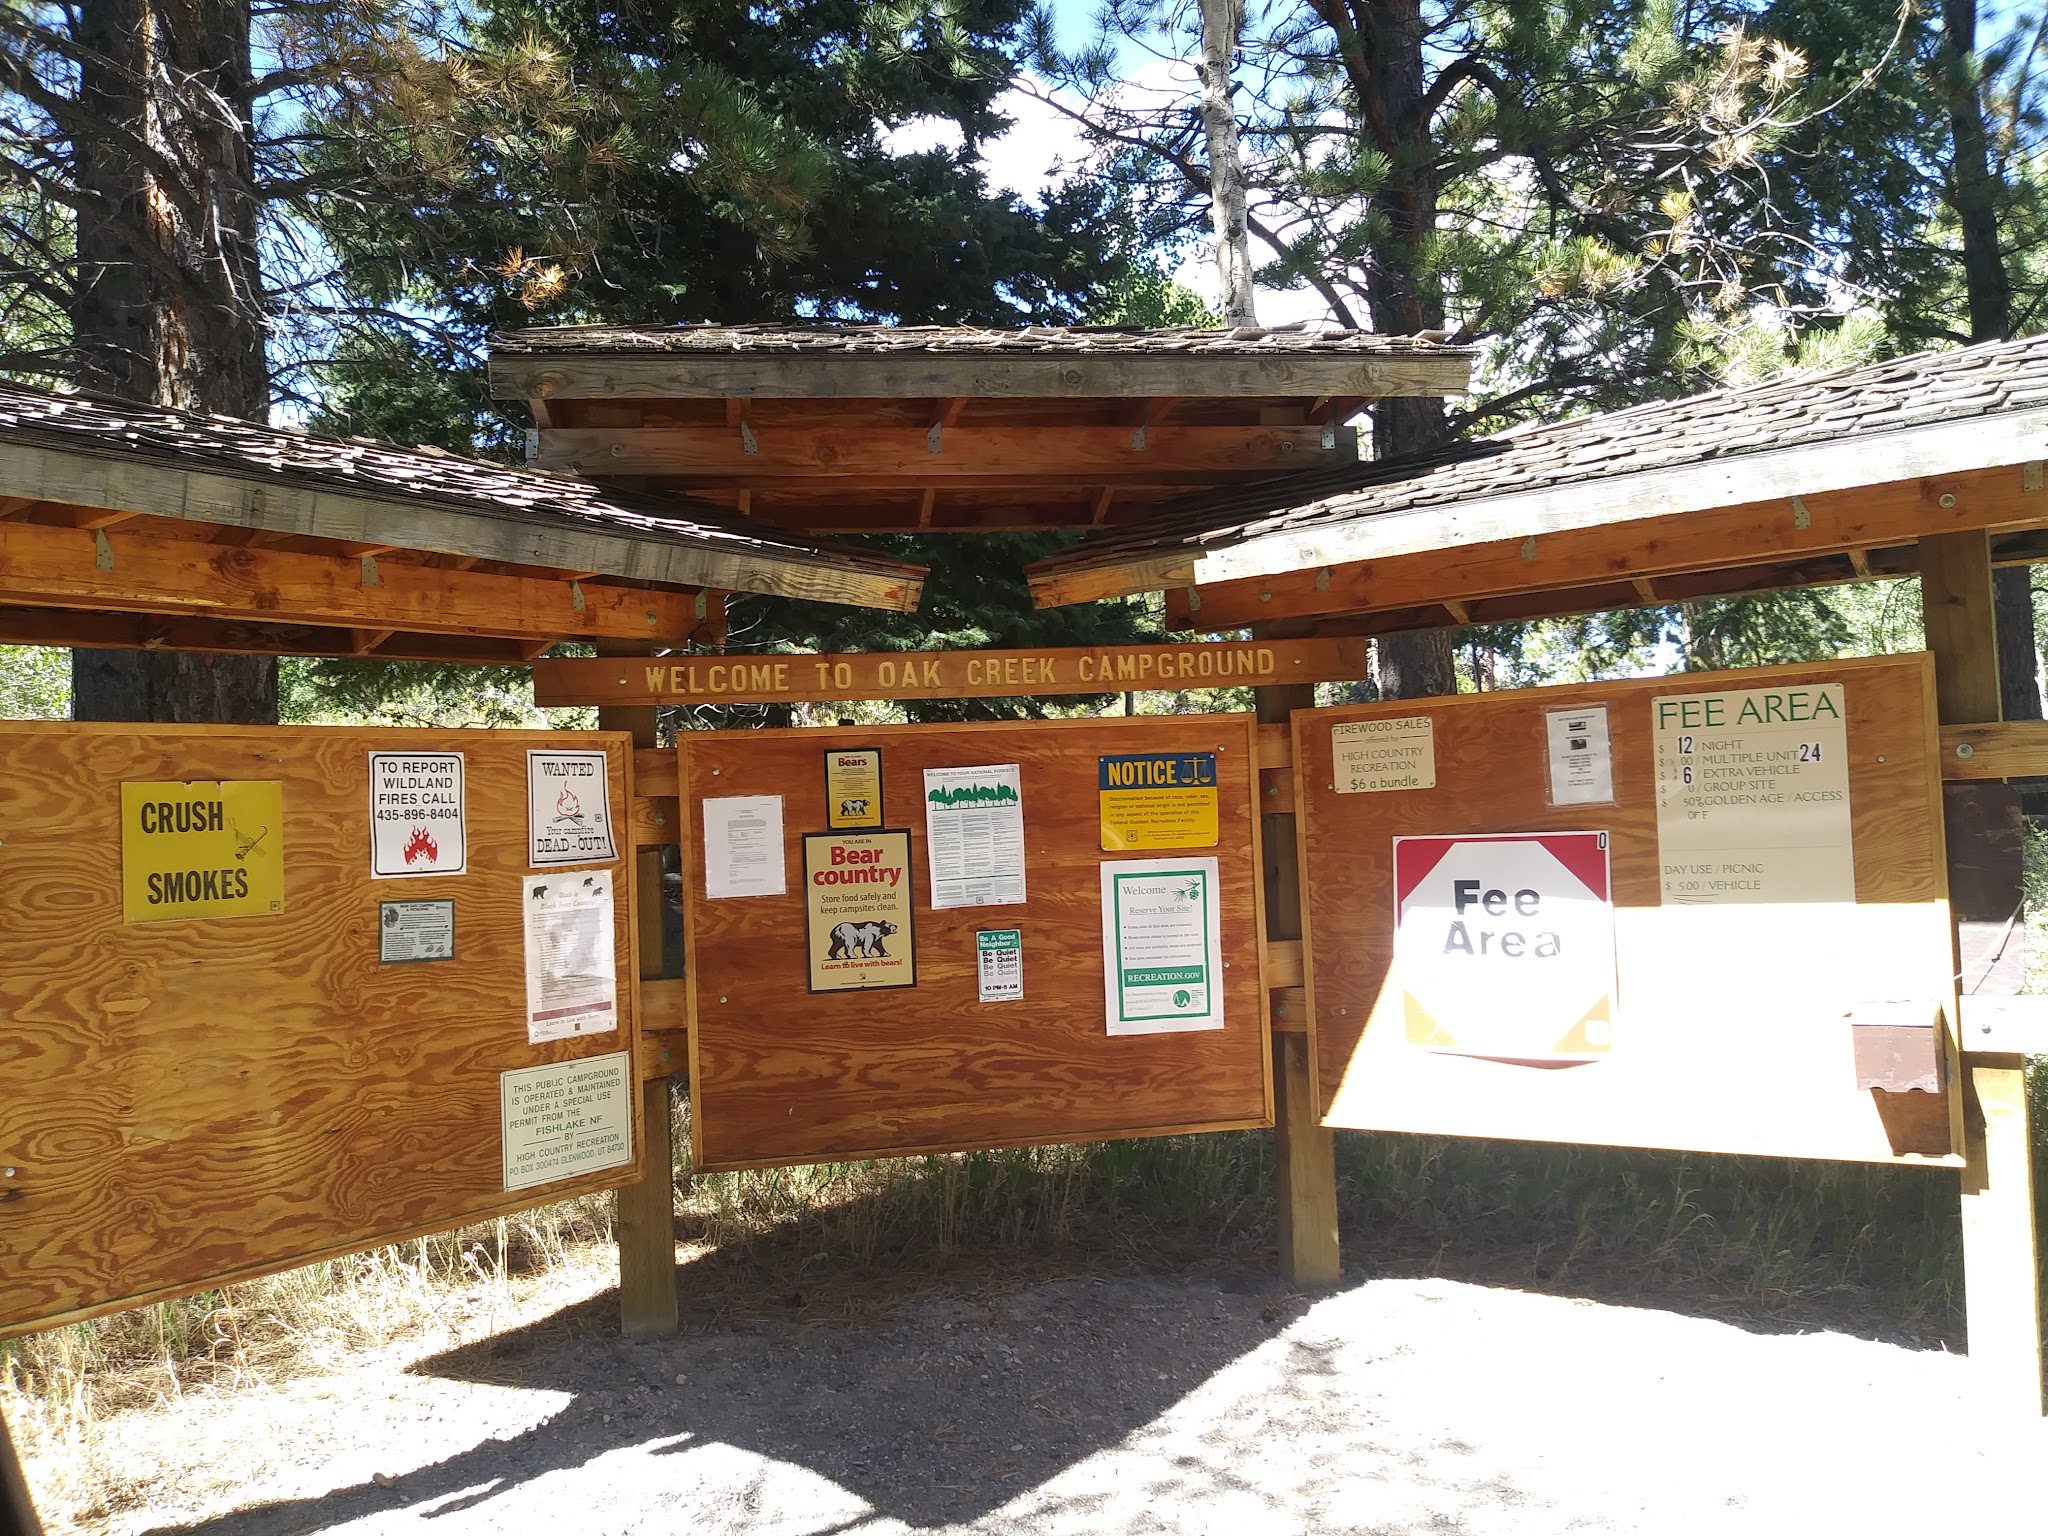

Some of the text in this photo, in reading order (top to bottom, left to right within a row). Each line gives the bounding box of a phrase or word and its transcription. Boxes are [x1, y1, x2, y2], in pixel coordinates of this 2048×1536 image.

[645, 648, 1275, 694] WELCOME TO OAK CREEK CAMPGROUND
[1659, 691, 1840, 730] FEE AREA
[1333, 718, 1431, 735] FIREWOOD SALES
[1364, 734, 1399, 744] offered by
[1678, 736, 1693, 754] 12
[1702, 740, 1744, 751] NIGHT
[1342, 747, 1425, 761] HIGH COUNTRY
[1702, 753, 1763, 764] MULTIPLE
[1767, 751, 1799, 761] UNIT
[1800, 743, 1821, 762] 24
[380, 762, 455, 773] TO REPORT
[542, 762, 594, 776] WANTED
[838, 757, 867, 767] Bears
[1350, 760, 1416, 774] RECREATION
[1107, 760, 1177, 786] NOTICE
[1684, 767, 1692, 784] 6
[1703, 768, 1744, 778] EXTRA
[1746, 765, 1800, 775] VEHICLE
[384, 778, 453, 789] WILDLAND
[1350, 775, 1419, 791] $6 a bundle
[1704, 781, 1746, 792] GROUP
[1749, 780, 1776, 790] SITE
[379, 793, 456, 804] FIRES CALL
[1705, 795, 1756, 805] GOLDEN
[1760, 793, 1784, 803] AGE
[1794, 791, 1843, 802] ACCESS
[141, 801, 223, 833] CRUSH
[377, 808, 458, 820] 435-896-8404
[1688, 811, 1708, 819] OFF
[546, 826, 594, 837] Your campfire
[830, 846, 884, 866] Bear
[1664, 864, 1764, 874] DAY USE PICNIC
[813, 865, 902, 888] country
[147, 868, 248, 904] SMOKES
[1122, 886, 1166, 895] Welcome
[1708, 880, 1760, 890] VEHICLE
[821, 891, 897, 904] Store food safely and
[1454, 879, 1540, 917] Fee
[820, 902, 898, 915] keep campsites clean.
[1129, 904, 1193, 914] Reserve Your Site!
[980, 940, 1012, 948] Neighbor
[1443, 921, 1561, 958] Area
[996, 948, 1017, 956] Quiet
[842, 961, 850, 969] to
[850, 961, 863, 969] live
[880, 958, 903, 967] bears!
[1127, 971, 1200, 983] RECREATION.GOV
[513, 1067, 619, 1094] THIS PUBLIC CAMPGROUND
[511, 1078, 621, 1106] IS OPERATED & MAINTAINED
[523, 1091, 612, 1116] UNDER A SPECIAL USE
[509, 1108, 581, 1129] PERMIT FROM THE
[536, 1115, 603, 1136] FISHLAKE NF
[564, 1132, 574, 1141] BY
[516, 1133, 620, 1163] HIGH COUNTRY RECREATION
[509, 1166, 519, 1176] PO
[521, 1163, 534, 1174] BOX
[597, 1146, 606, 1156] UT
